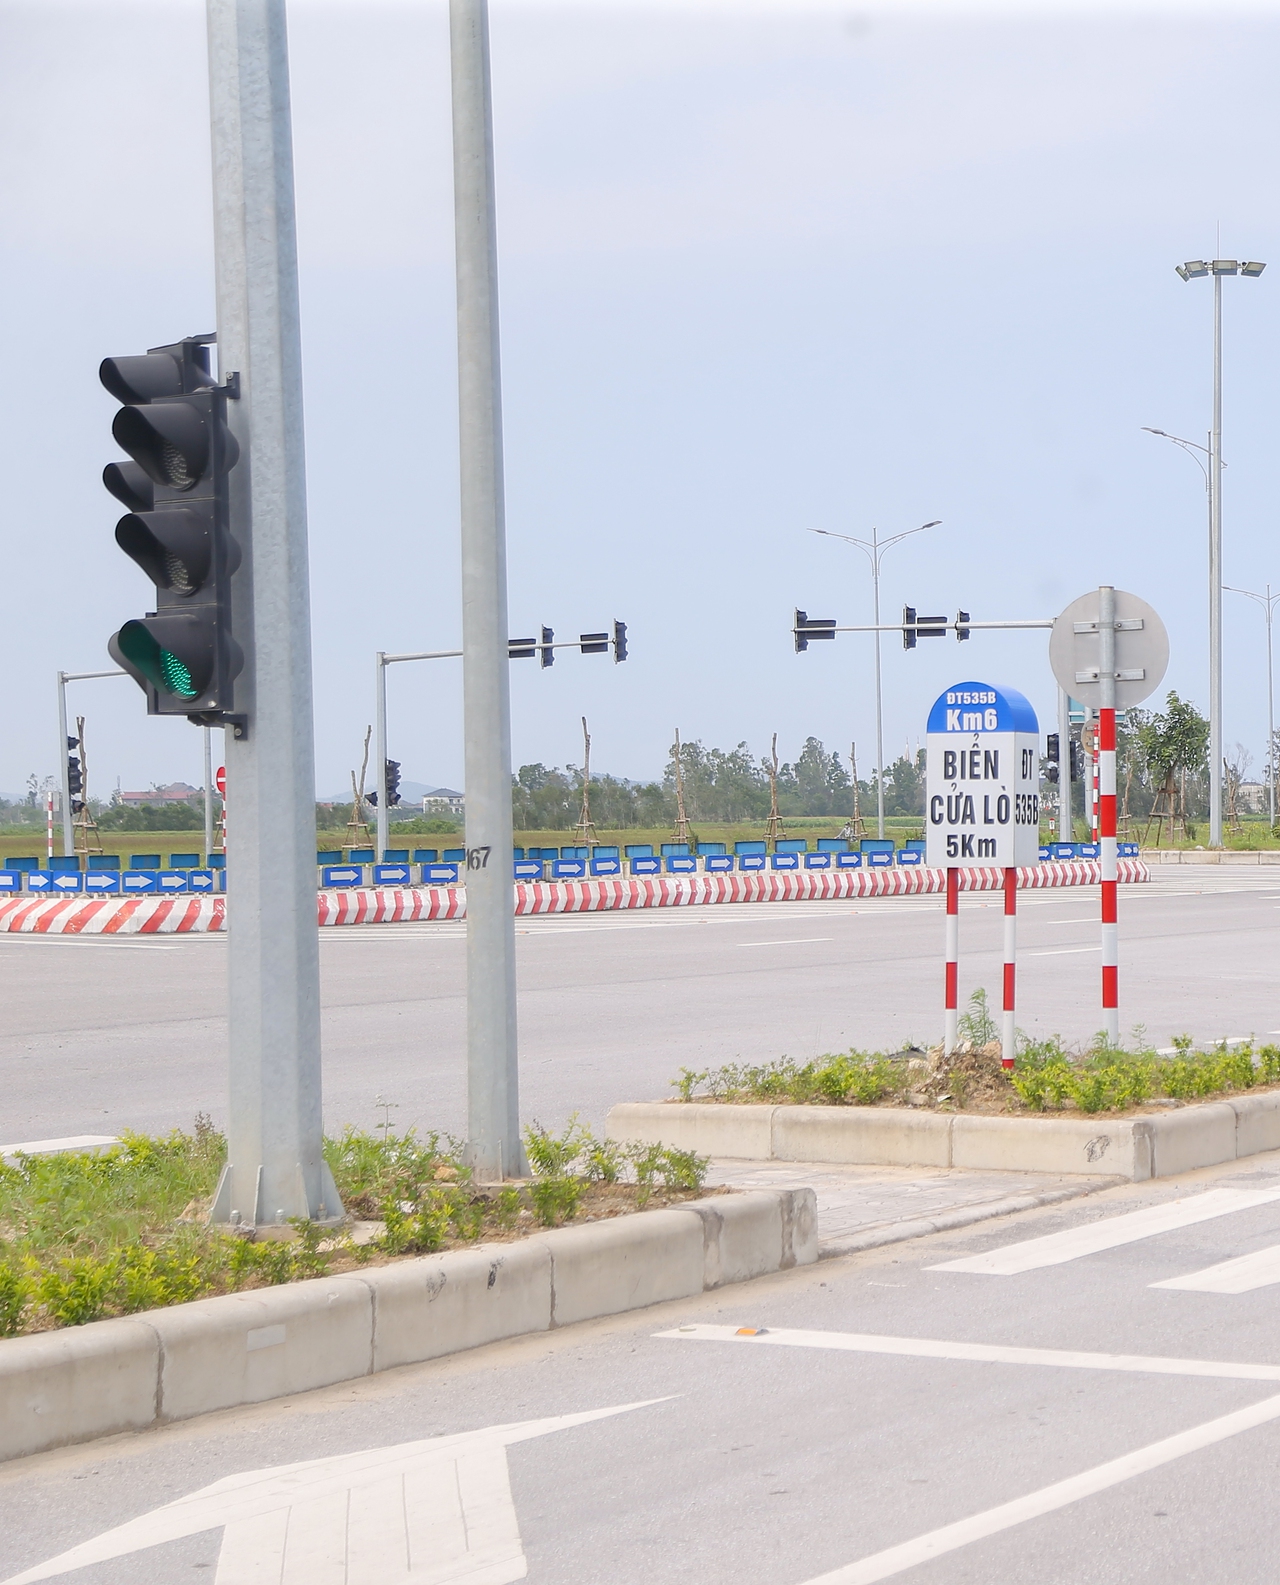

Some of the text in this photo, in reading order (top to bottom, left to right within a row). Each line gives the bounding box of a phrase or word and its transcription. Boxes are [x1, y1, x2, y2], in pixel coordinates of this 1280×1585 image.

[946, 692, 996, 705] ĐT535B
[946, 708, 998, 731] Km6
[943, 733, 999, 780] BIỂN
[1021, 748, 1034, 780] ĐT
[930, 782, 1011, 825] CỬA LÒ
[1015, 793, 1039, 826] 535B
[946, 833, 997, 858] 5Km
